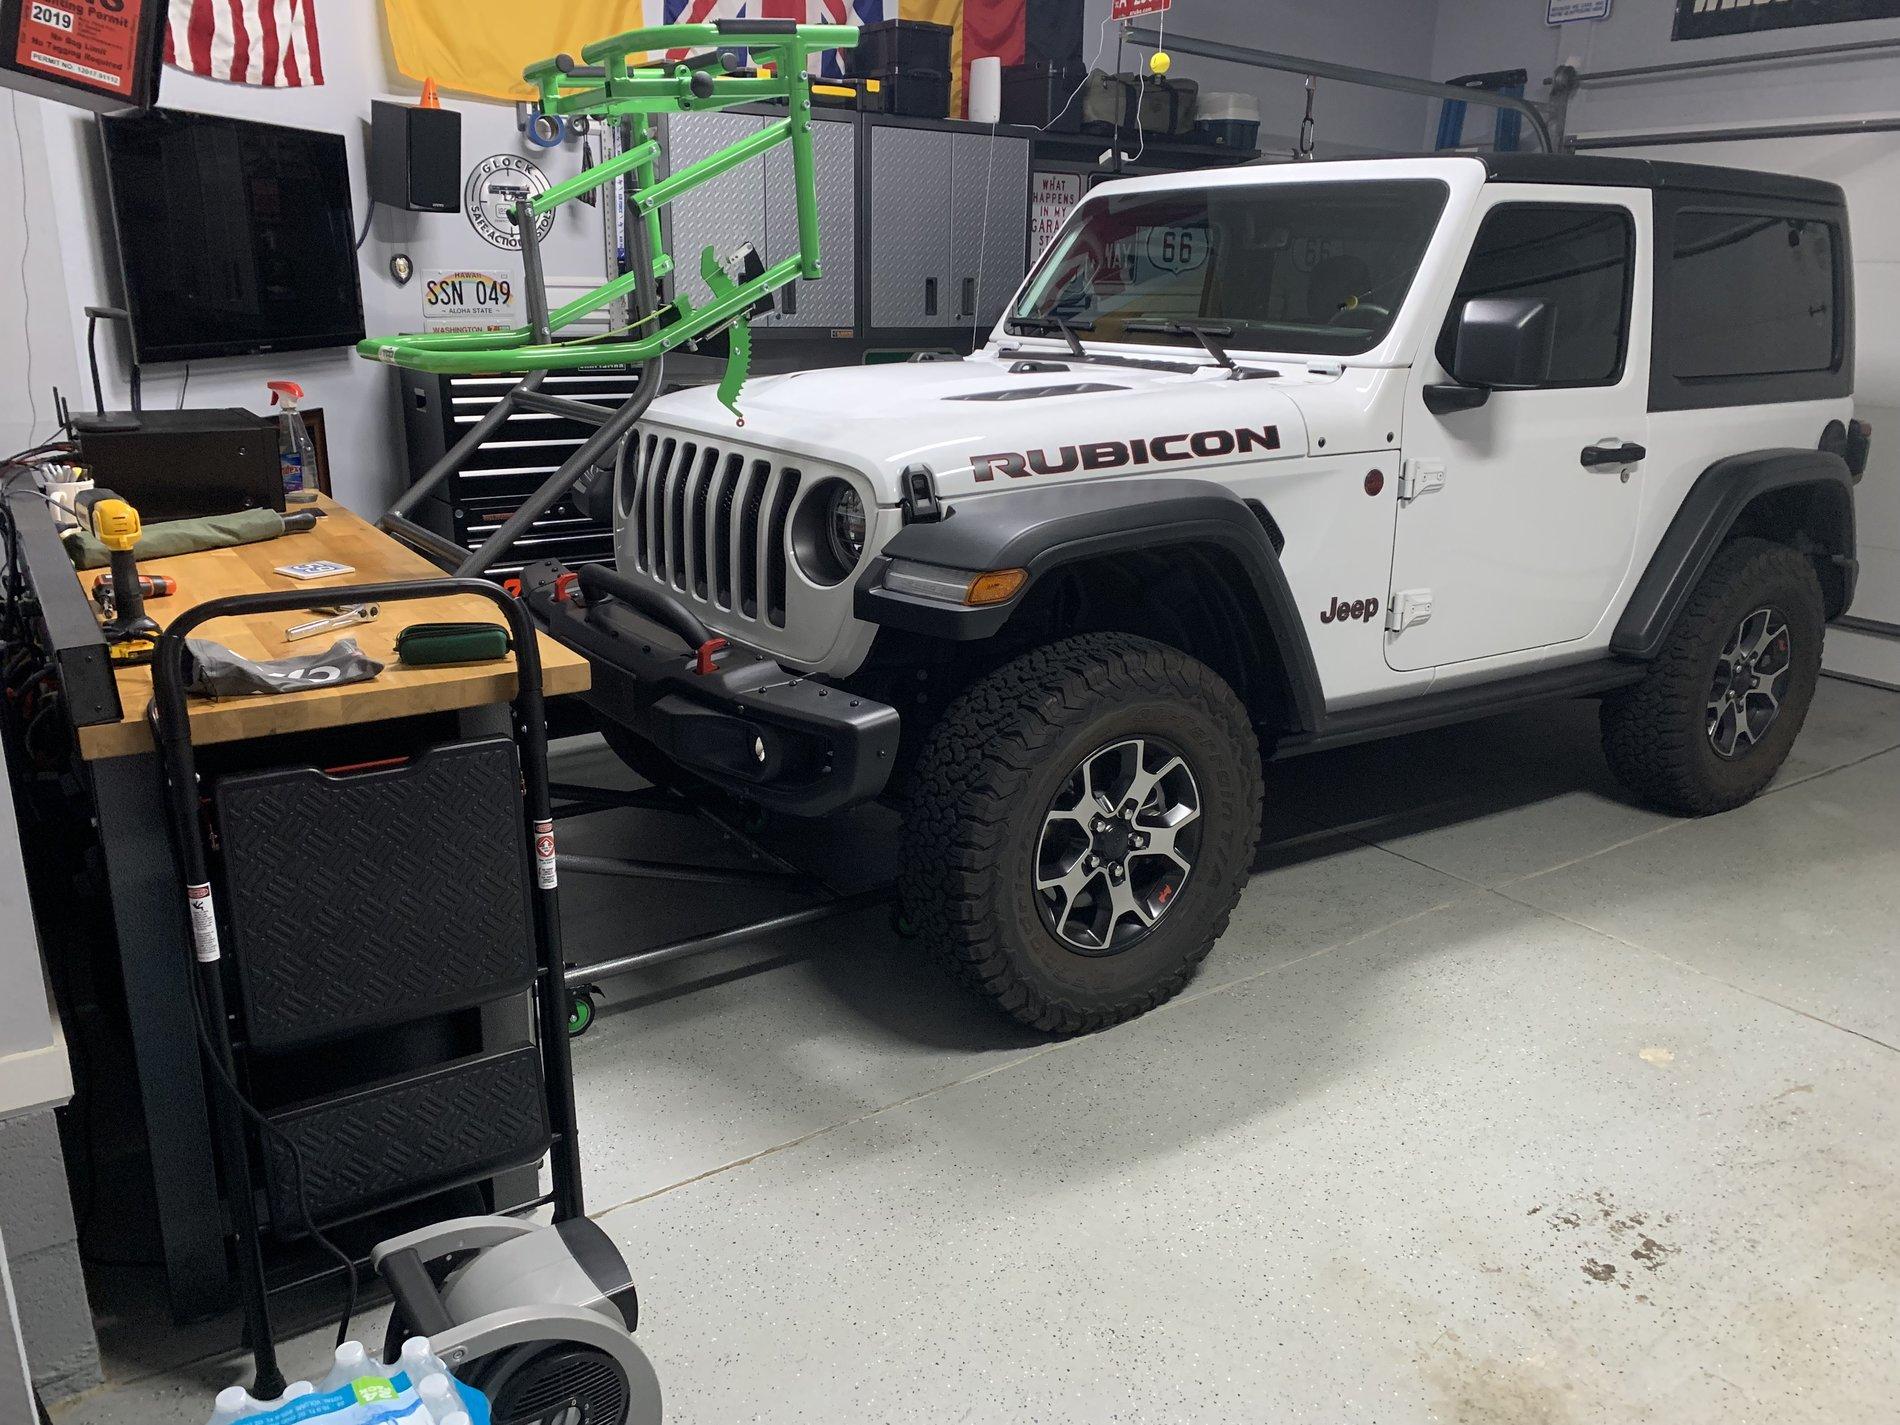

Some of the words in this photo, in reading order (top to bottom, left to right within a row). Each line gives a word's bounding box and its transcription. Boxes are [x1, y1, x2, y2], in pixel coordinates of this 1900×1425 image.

[33, 5, 72, 29] 2019
[88, 7, 128, 28] Permit
[31, 37, 44, 46] No
[47, 41, 82, 60] Tagging
[84, 53, 123, 71] Required
[85, 42, 107, 56] Limit
[32, 52, 60, 65] PERMIT
[482, 157, 534, 175] GLOCK
[1042, 180, 1066, 191] WHAT
[1032, 190, 1075, 205] HAPPENS
[1040, 207, 1049, 217] IN
[1054, 207, 1067, 217] MY
[1031, 219, 1065, 233] GARA
[1162, 231, 1193, 263] 66
[427, 280, 464, 305] SSN
[476, 280, 511, 305] 049
[432, 325, 483, 333] WASHINGTON
[969, 425, 1281, 483] RUBICON
[1320, 596, 1379, 624] Jeep
[362, 1389, 393, 1402] 24
